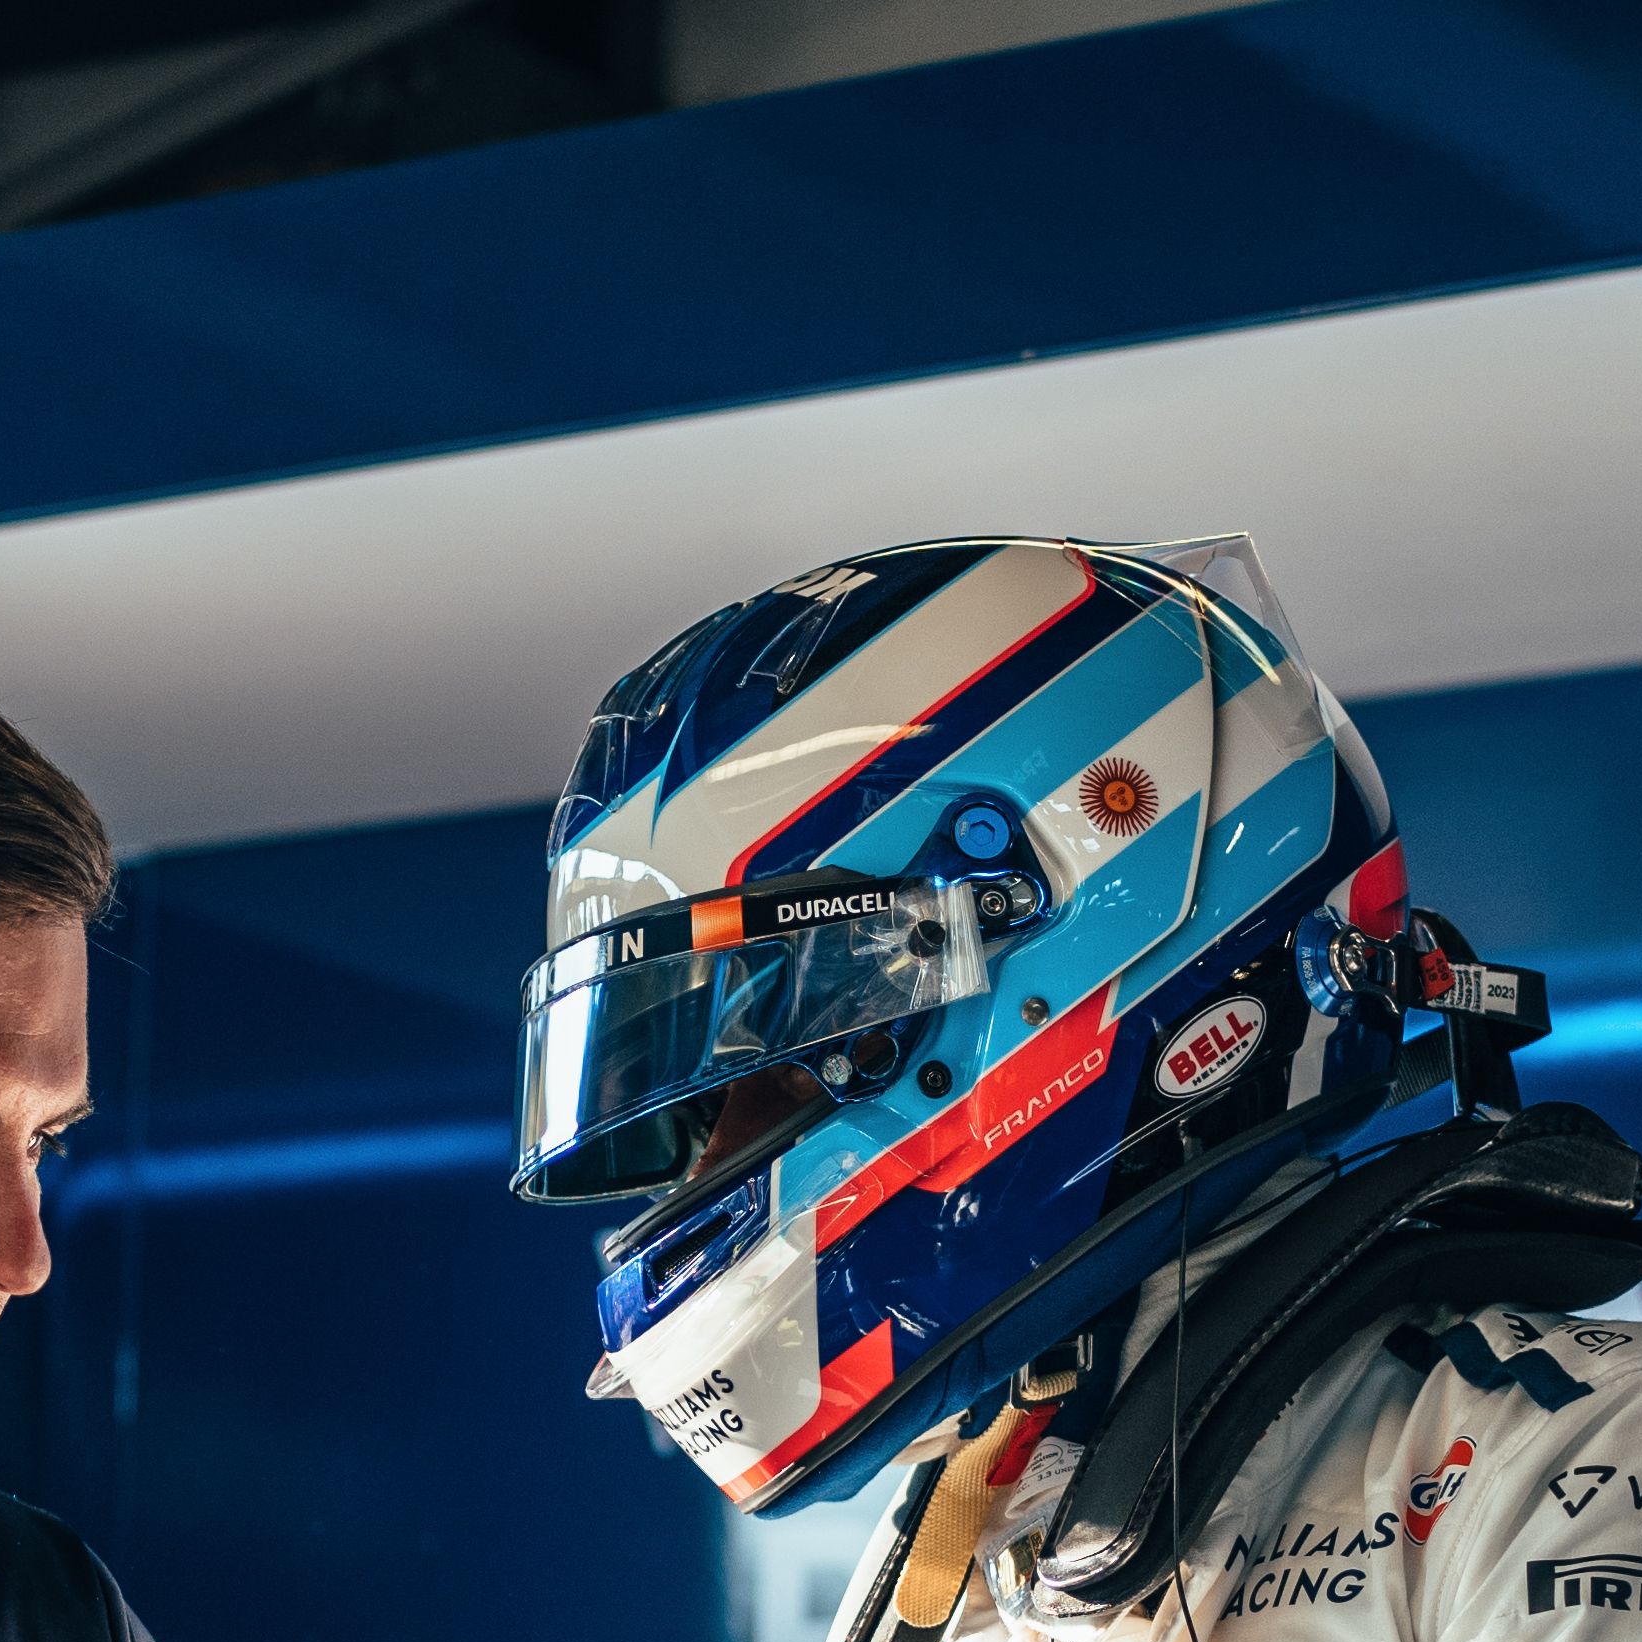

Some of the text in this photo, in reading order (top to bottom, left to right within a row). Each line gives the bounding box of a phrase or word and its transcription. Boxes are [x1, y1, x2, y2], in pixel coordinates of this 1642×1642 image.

[1487, 984, 1516, 1000] 2023
[1167, 1011, 1255, 1086] BELL
[1192, 1039, 1250, 1087] HELMETS
[983, 1046, 1105, 1151] FRANCO
[1410, 1472, 1467, 1509] Glf
[1221, 1567, 1367, 1620] ACING
